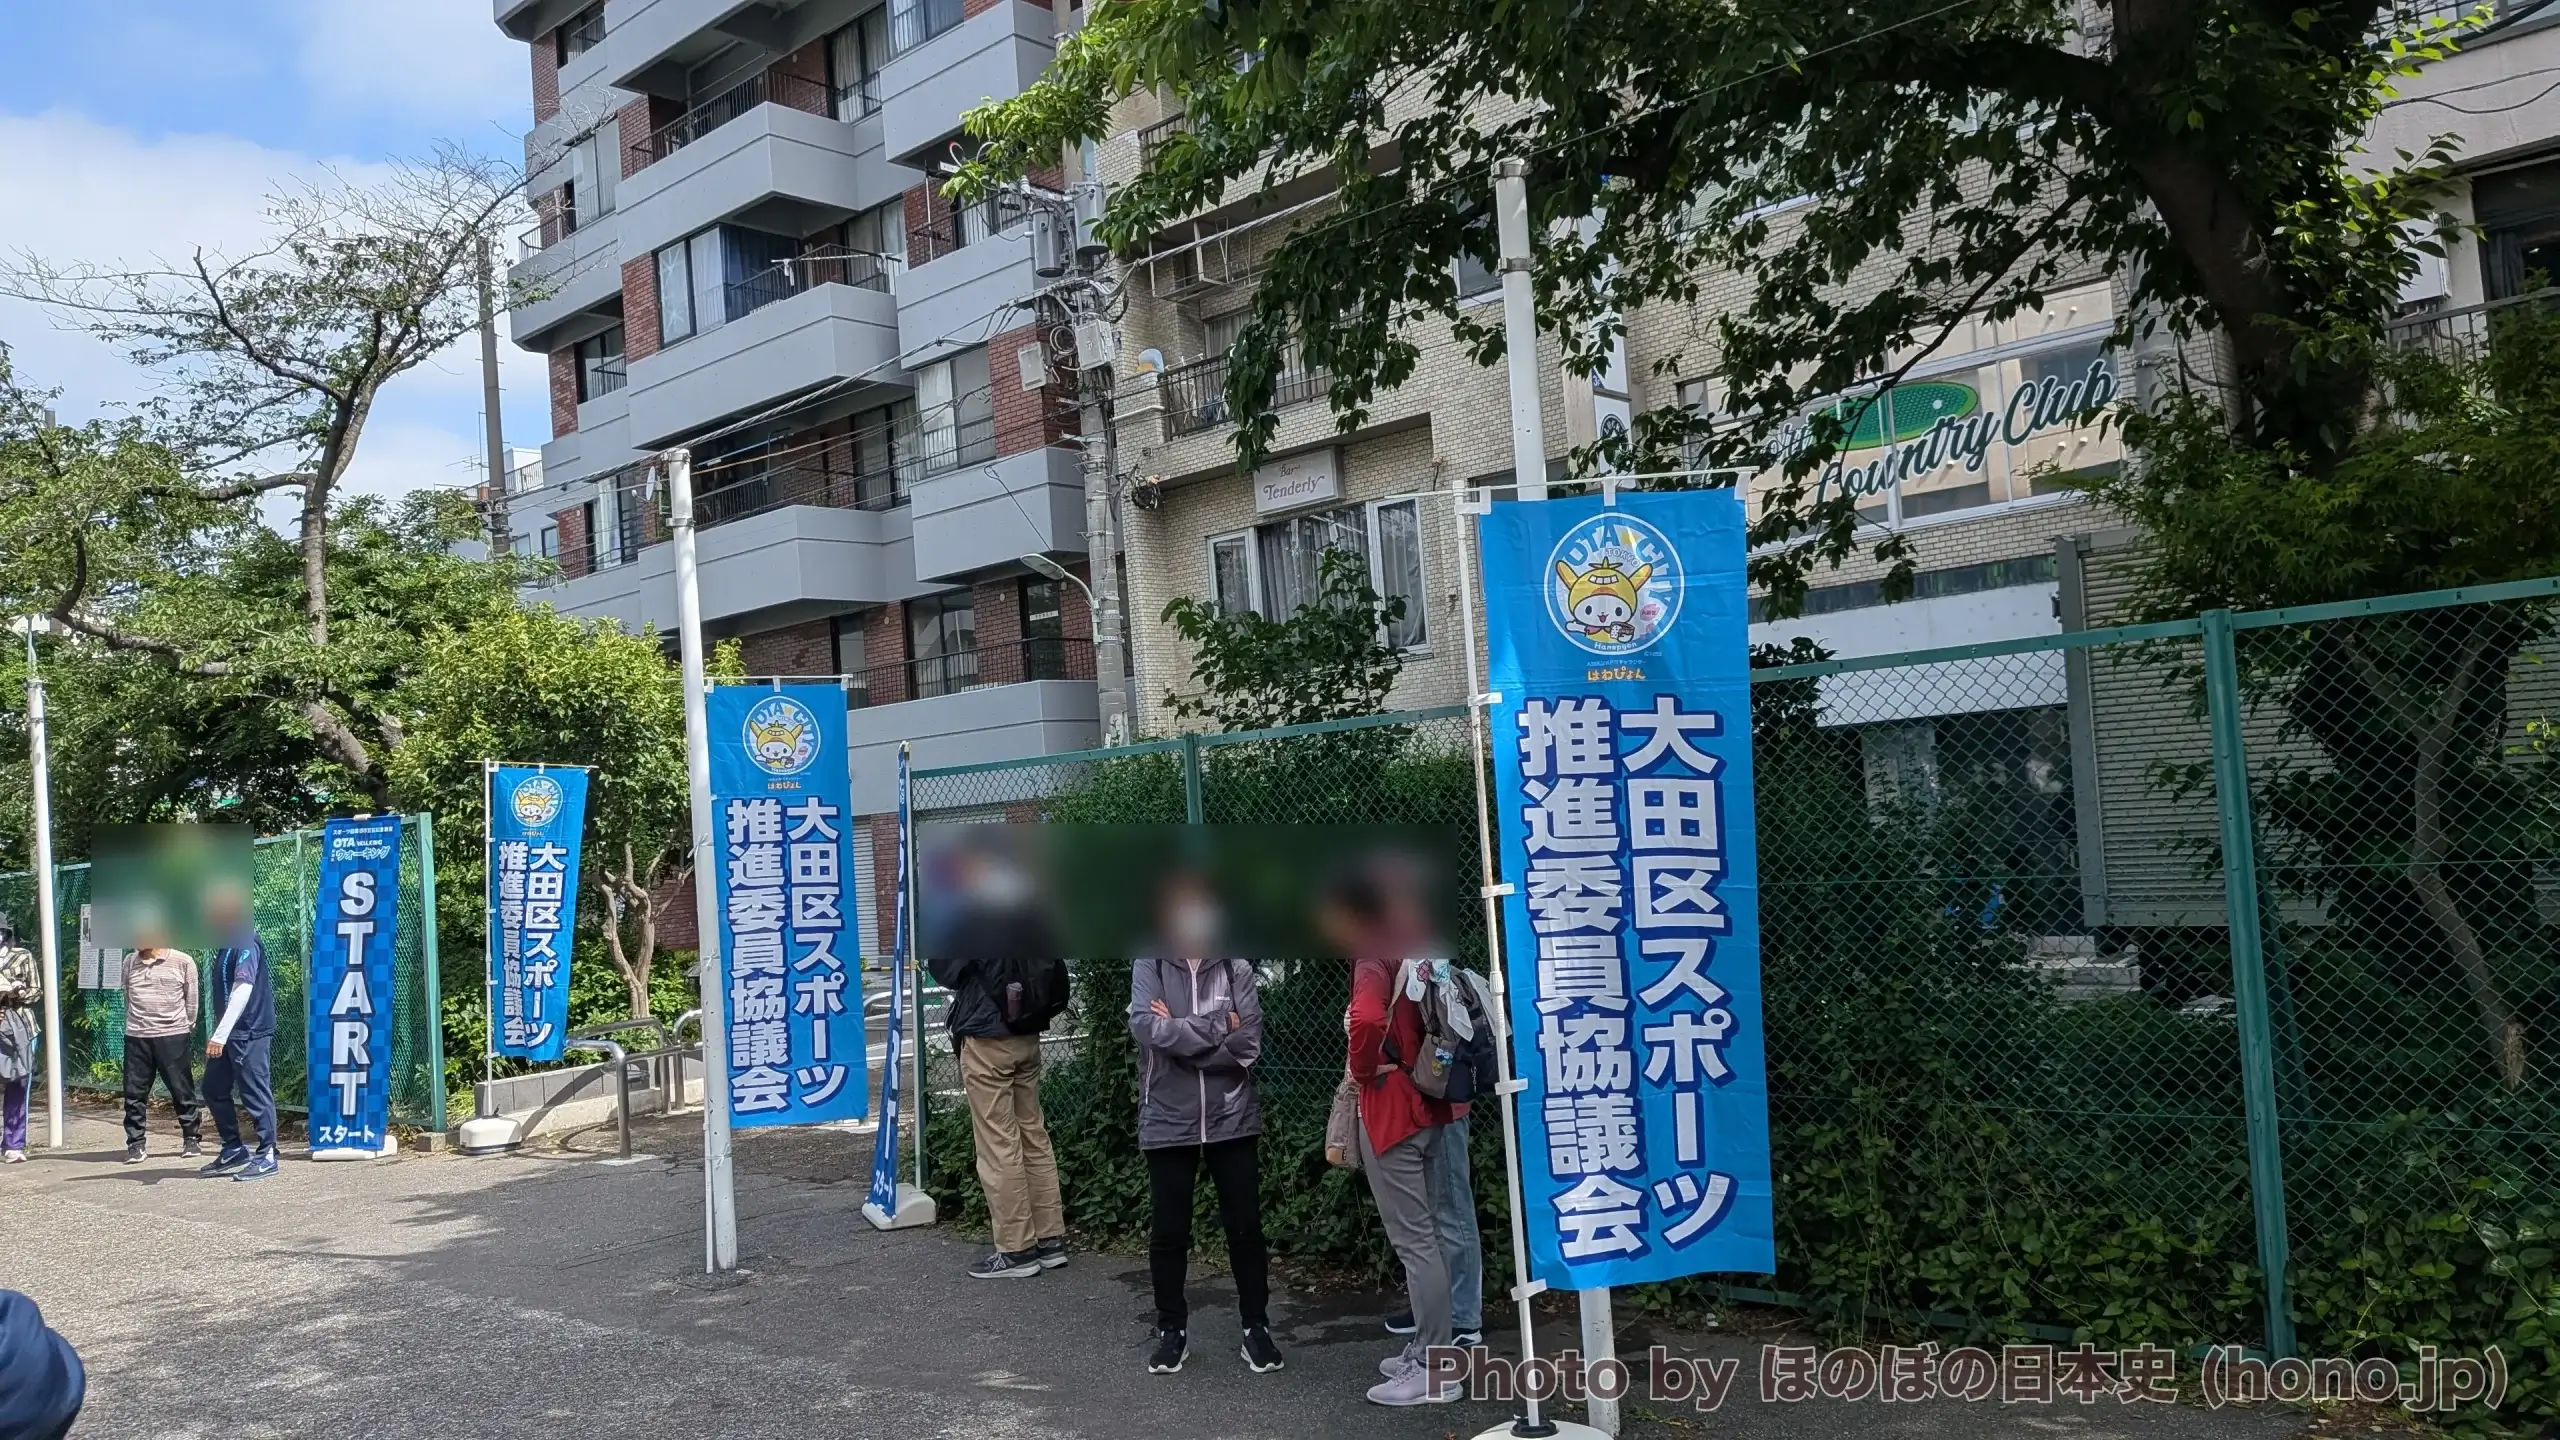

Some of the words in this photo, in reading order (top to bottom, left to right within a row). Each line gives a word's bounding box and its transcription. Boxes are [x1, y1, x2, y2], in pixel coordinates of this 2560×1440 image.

[1263, 476, 1325, 500] Tenderly
[1280, 464, 1300, 477] Bar
[1816, 411, 2001, 505] Country
[2002, 359, 2121, 446] Club
[1606, 548, 1640, 567] TOKYO
[1594, 641, 1637, 651] Hanepyon
[333, 837, 355, 848] OTA
[335, 845, 391, 861] ウォーキング
[331, 872, 374, 1116] START
[499, 841, 528, 1047] 推進委員協議会
[523, 841, 567, 1048] 大田区スポーツ
[728, 798, 789, 1112] 推進委員協議会
[787, 797, 847, 1106] 大田区スポーツ
[1518, 698, 1645, 1260] 推進委員協議会
[1621, 696, 1732, 1245] 大田区スポーツ
[319, 1125, 376, 1144] スタート
